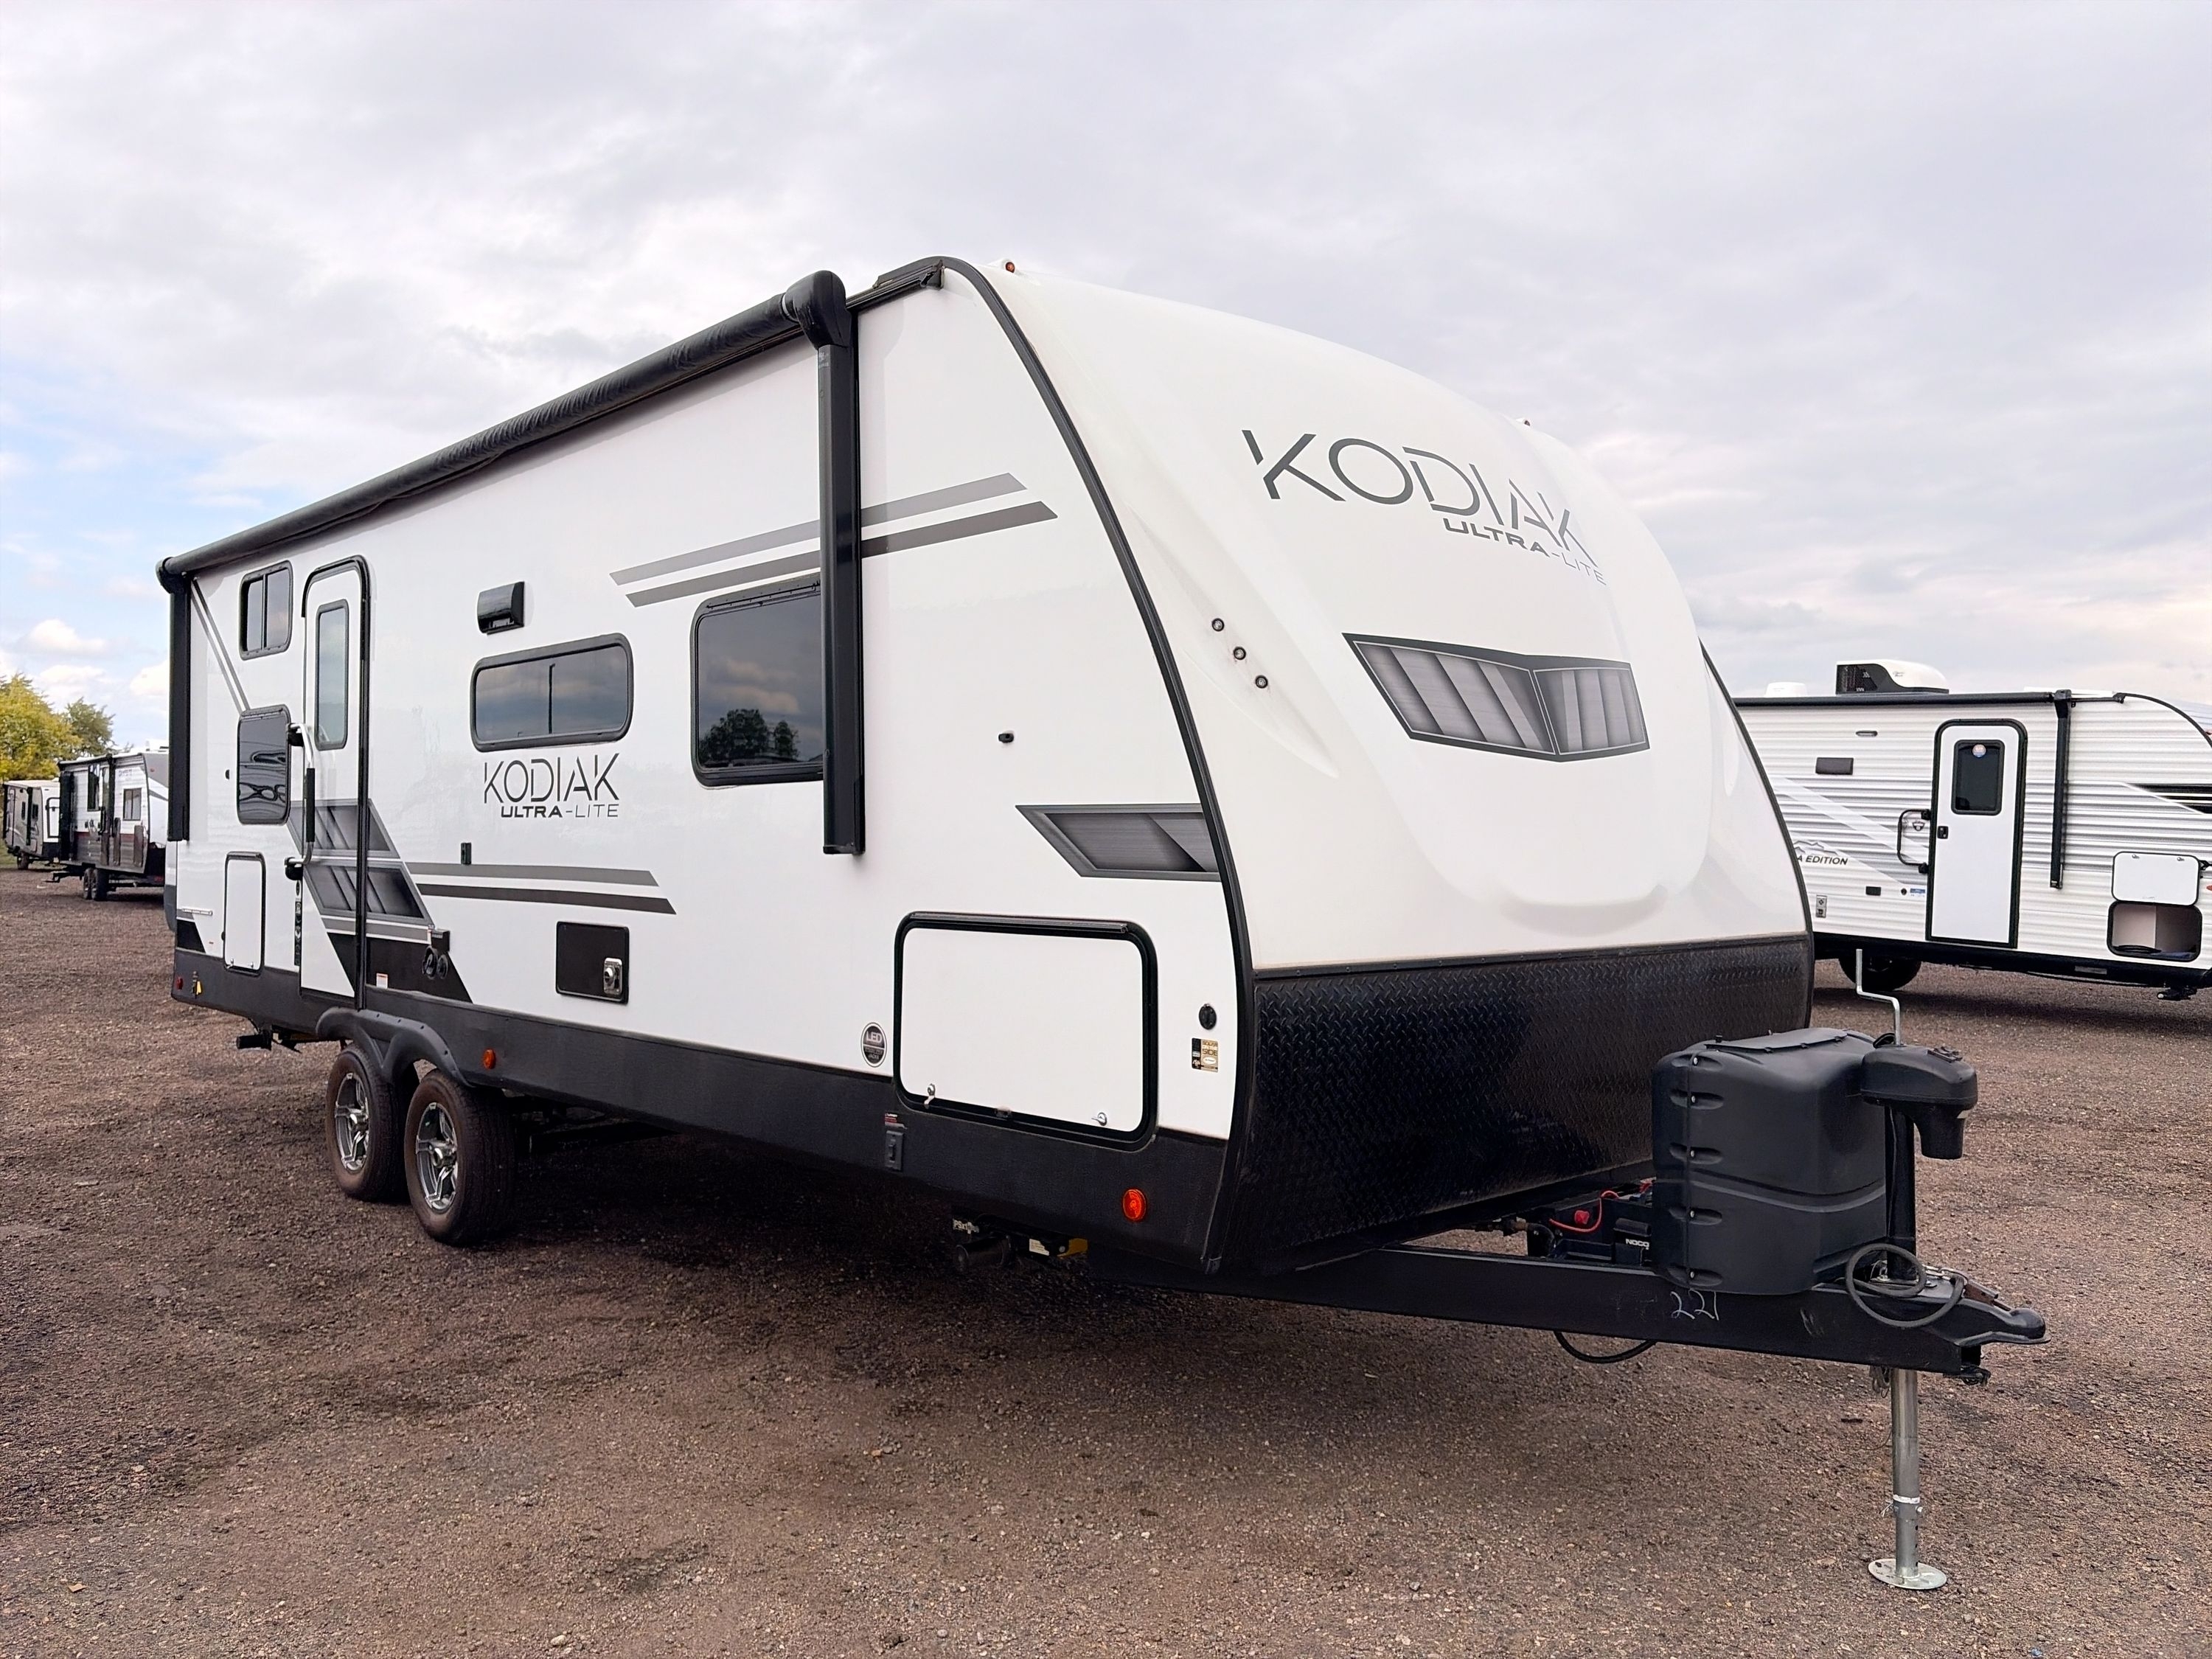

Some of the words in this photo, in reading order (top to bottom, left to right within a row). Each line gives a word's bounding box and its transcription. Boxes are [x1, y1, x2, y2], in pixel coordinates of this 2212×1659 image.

[1241, 429, 1599, 568] KODIAK
[1443, 518, 1607, 586] ULTRA-LITE
[484, 753, 620, 804] KODIAK
[501, 804, 619, 818] ULTRA-LITE
[1806, 855, 1848, 865] EDITION
[866, 1031, 883, 1043] LED
[1625, 1239, 1650, 1248] NOCO
